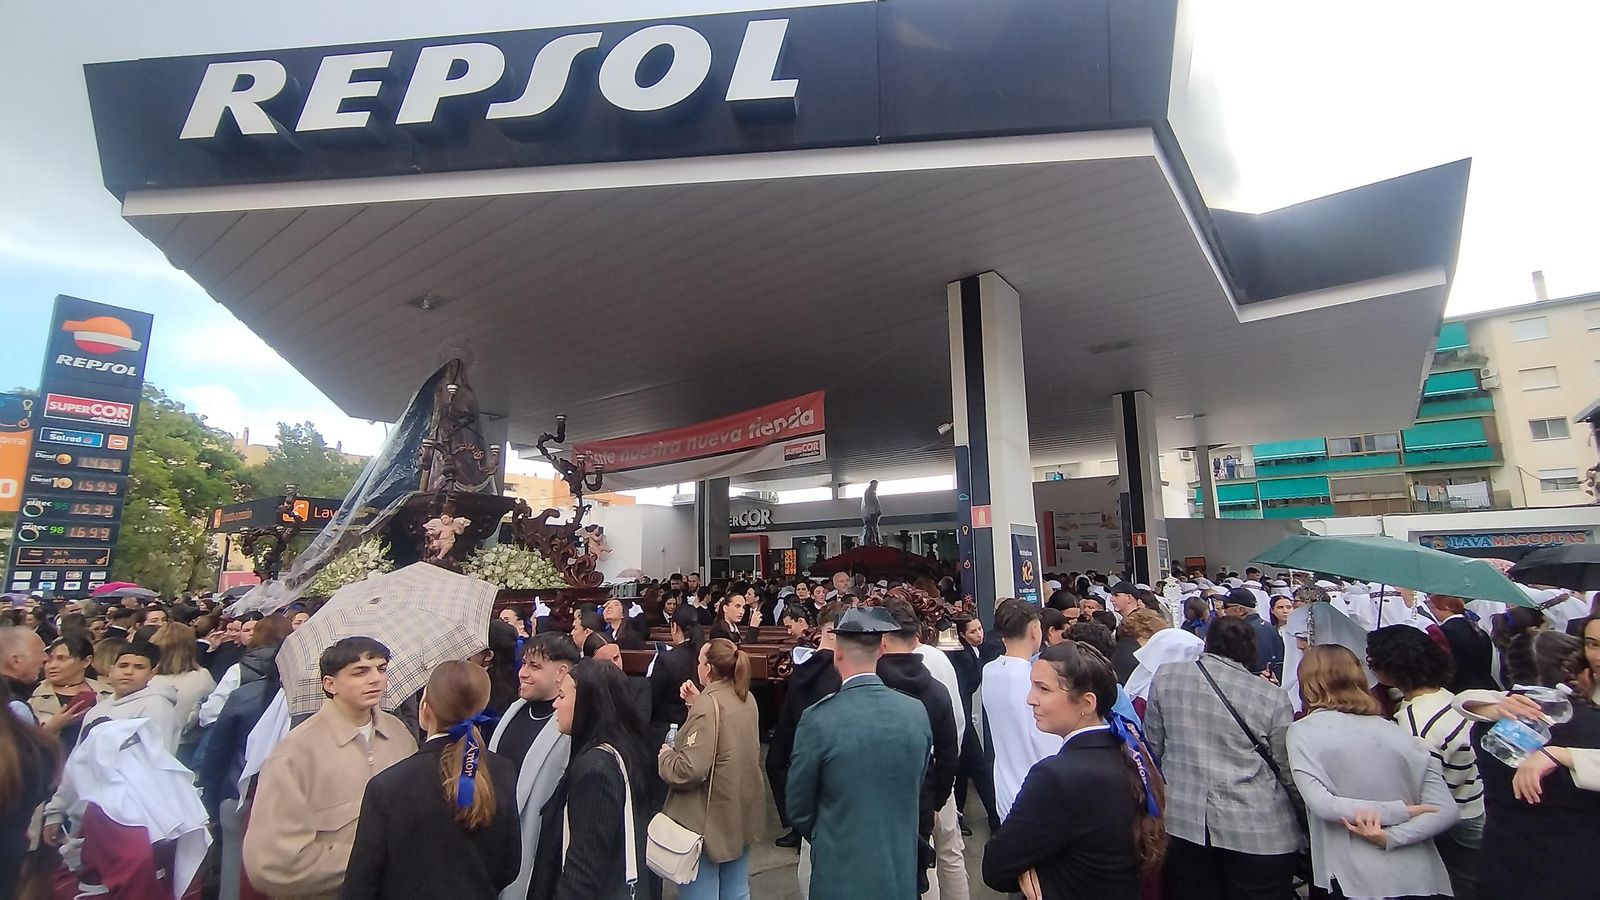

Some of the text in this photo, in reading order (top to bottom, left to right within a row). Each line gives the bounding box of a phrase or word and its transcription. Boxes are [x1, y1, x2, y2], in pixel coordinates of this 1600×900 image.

[179, 18, 800, 140] REPSOL
[56, 354, 137, 376] REPSOL
[48, 401, 129, 419] SUPERCOR
[49, 433, 82, 443] Solred
[620, 440, 681, 462] nuestra
[687, 427, 742, 450] nueva
[749, 406, 814, 439] tienda
[314, 506, 340, 519] Lav
[49, 526, 65, 534] 98
[464, 741, 479, 777] Amor
